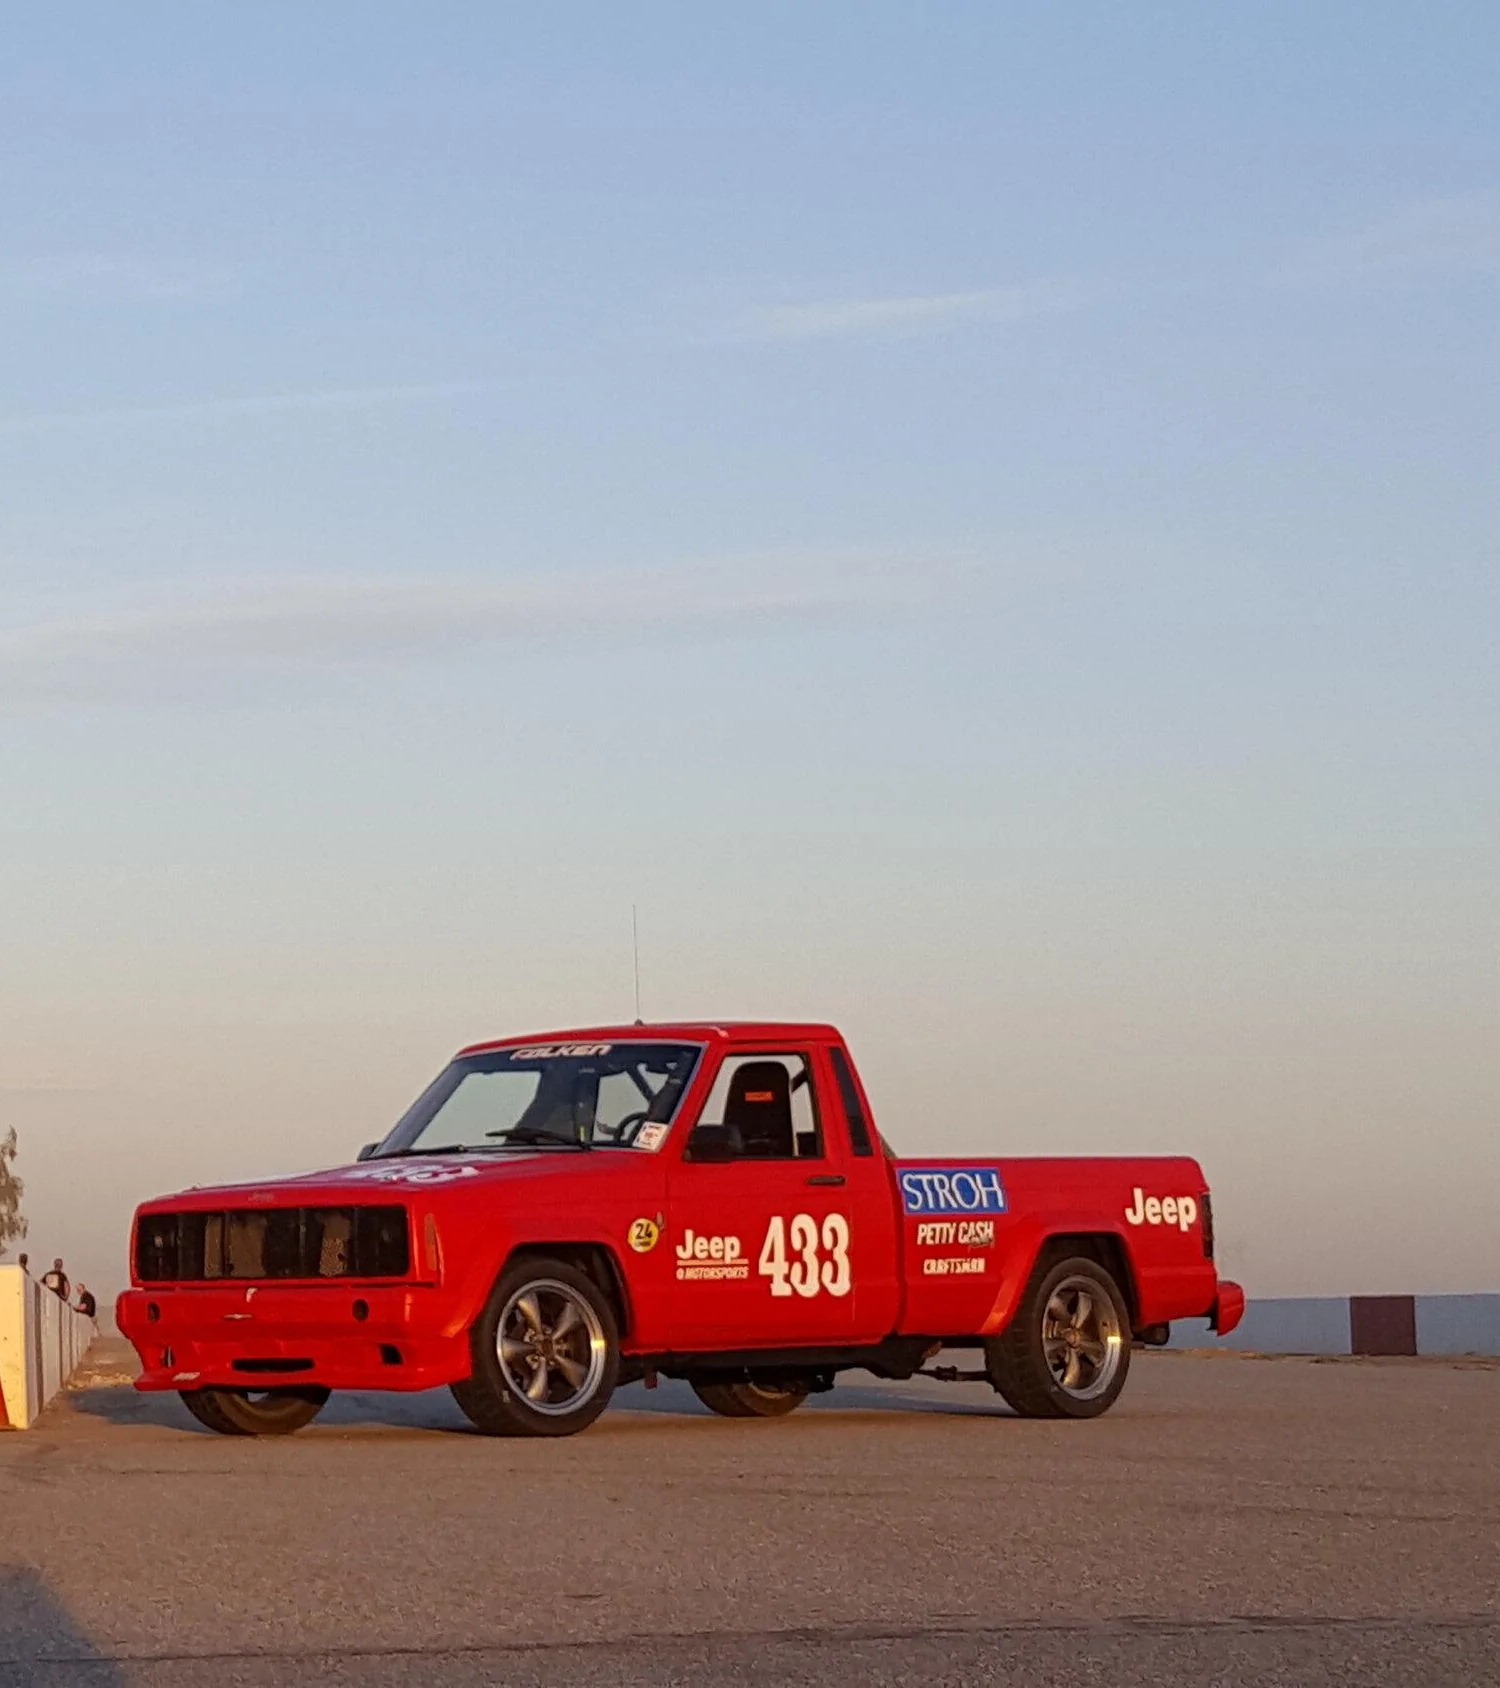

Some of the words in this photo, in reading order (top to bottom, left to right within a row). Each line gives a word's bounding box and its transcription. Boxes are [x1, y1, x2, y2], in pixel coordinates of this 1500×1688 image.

[902, 1173, 1004, 1210] STROH
[1125, 1187, 1197, 1232] Jeep
[635, 1222, 653, 1239] 24
[675, 1229, 741, 1264] Jeep
[916, 1223, 957, 1245] PETTY
[958, 1221, 994, 1245] CASH
[758, 1213, 851, 1297] 433
[923, 1258, 985, 1275] CRAFTSMAN
